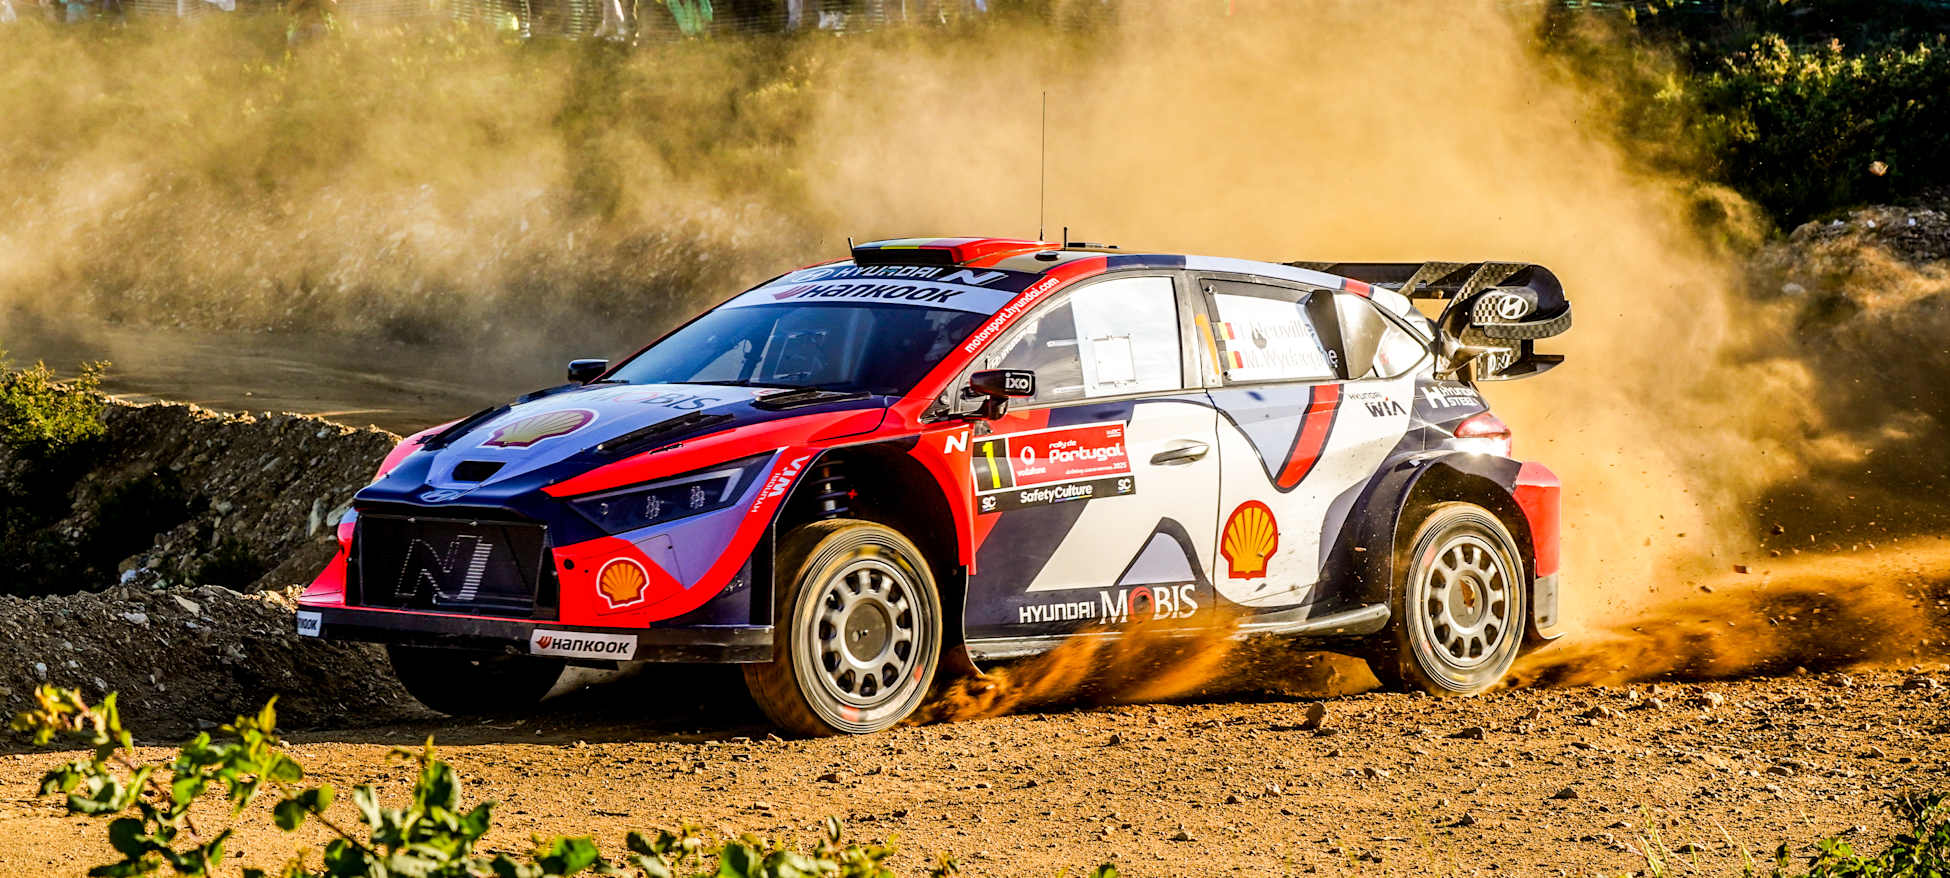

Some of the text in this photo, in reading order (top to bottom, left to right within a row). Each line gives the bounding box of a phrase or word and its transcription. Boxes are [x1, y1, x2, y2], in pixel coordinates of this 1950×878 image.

[832, 264, 943, 279] HYUNDAI
[964, 277, 1060, 353] motorsport.hyundai.com
[944, 431, 969, 453] N
[1049, 443, 1124, 463] Portugal
[982, 441, 1001, 488] 1
[982, 478, 1132, 508] SC SafetyCulture SC
[1019, 583, 1199, 625] HYUNDAI MOBIS
